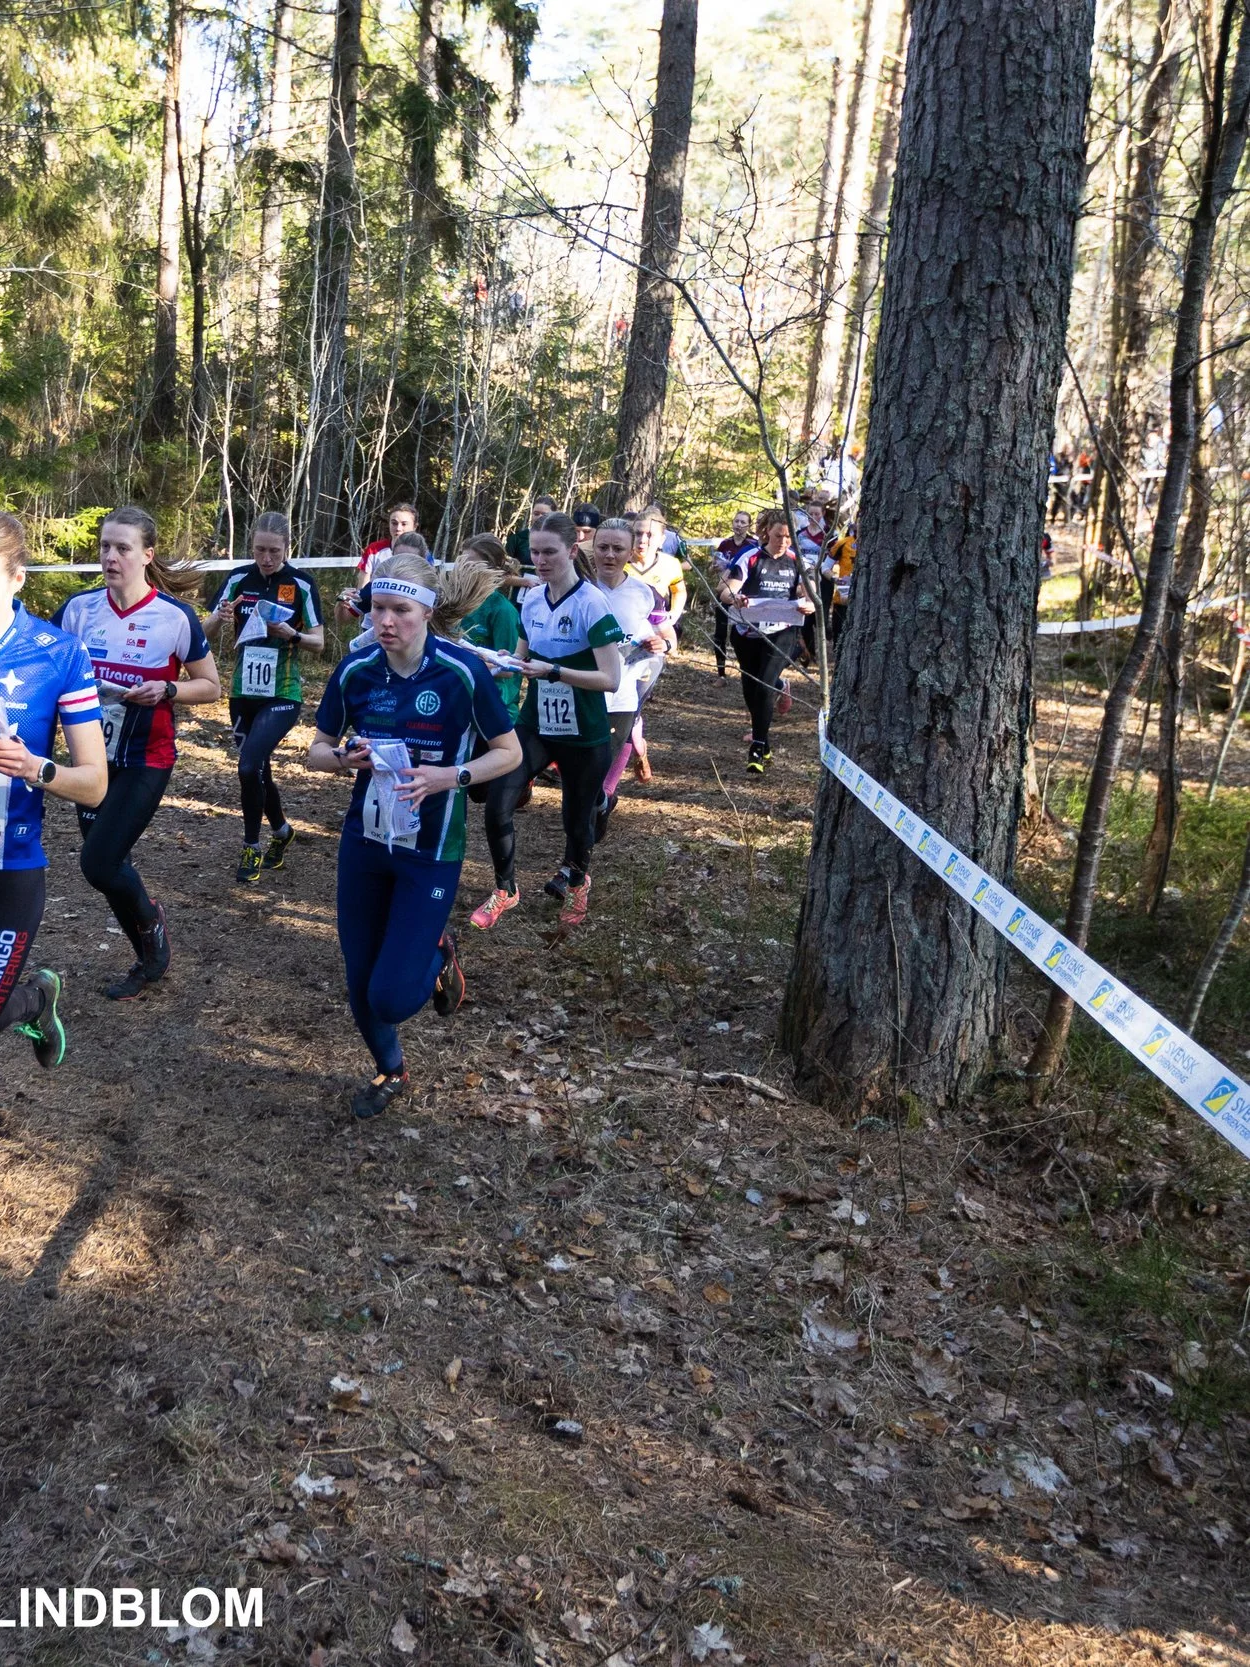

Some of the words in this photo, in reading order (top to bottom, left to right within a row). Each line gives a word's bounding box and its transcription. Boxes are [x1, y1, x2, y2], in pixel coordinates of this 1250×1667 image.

[99, 666, 144, 684] Tisaren
[247, 661, 271, 686] 110
[543, 697, 571, 724] 112
[404, 737, 442, 747] noname
[1060, 953, 1087, 980] SVENSK
[1108, 994, 1140, 1023] SVENSK
[1156, 1054, 1190, 1085] ORIENTERING
[1164, 1041, 1200, 1075] SVENSK
[1230, 1097, 1250, 1123] SVE
